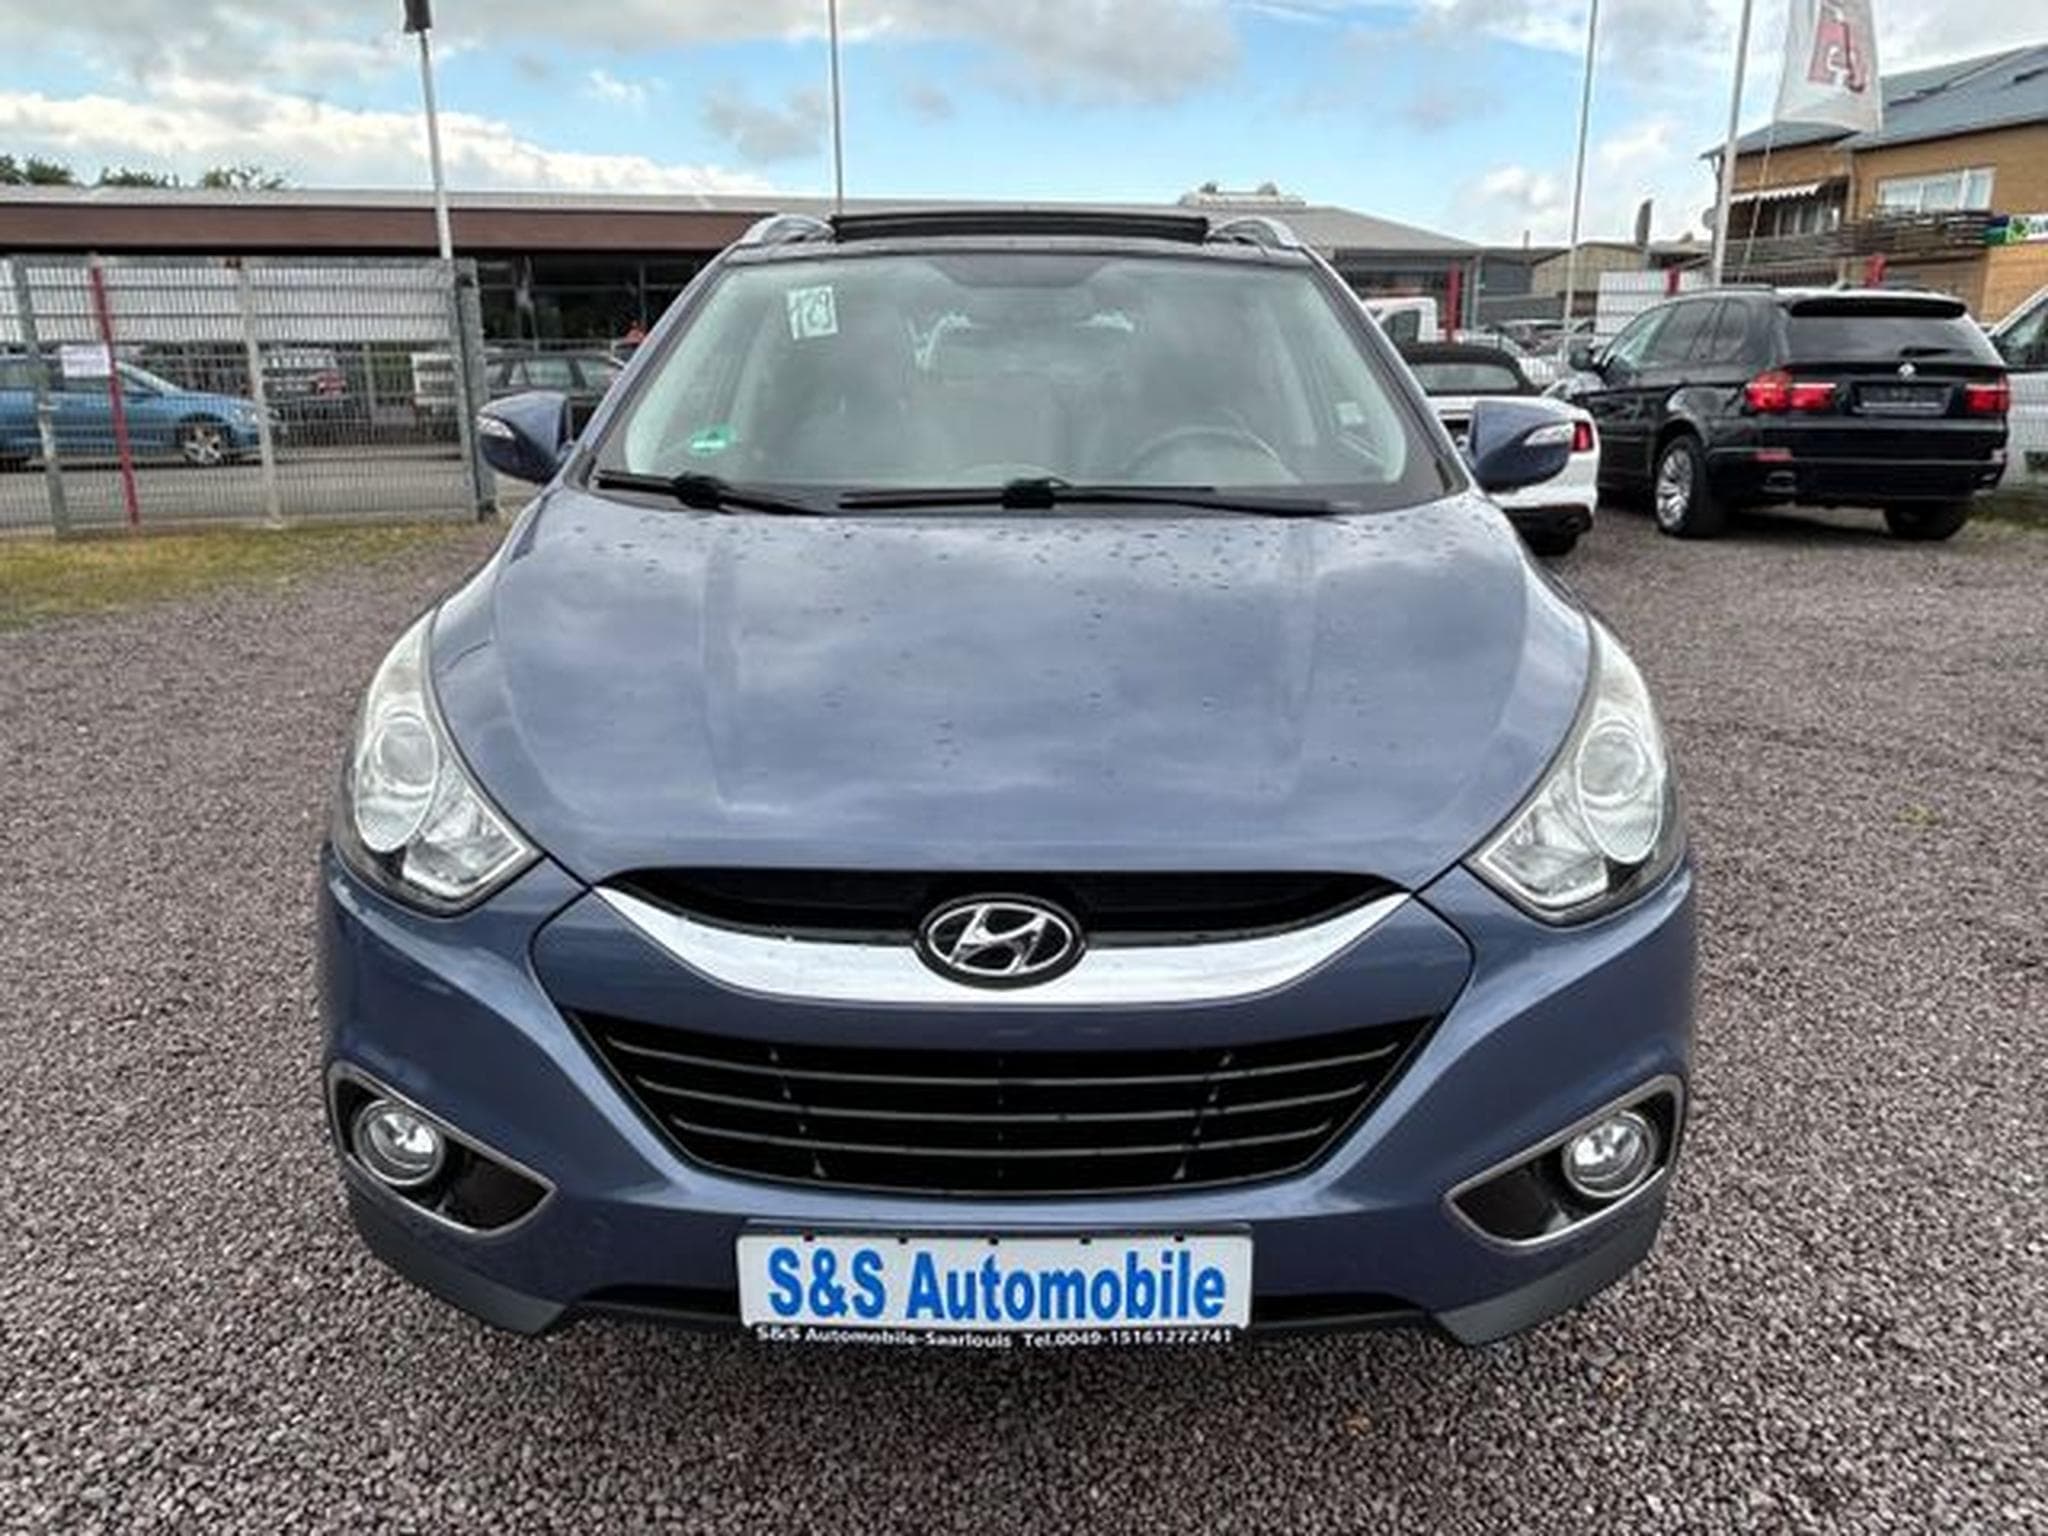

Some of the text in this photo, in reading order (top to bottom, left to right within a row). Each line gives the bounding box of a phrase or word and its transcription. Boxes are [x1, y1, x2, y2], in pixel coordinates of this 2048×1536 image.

[767, 1246, 1226, 1322] S&S Automobile
[756, 1325, 800, 1342] S&S
